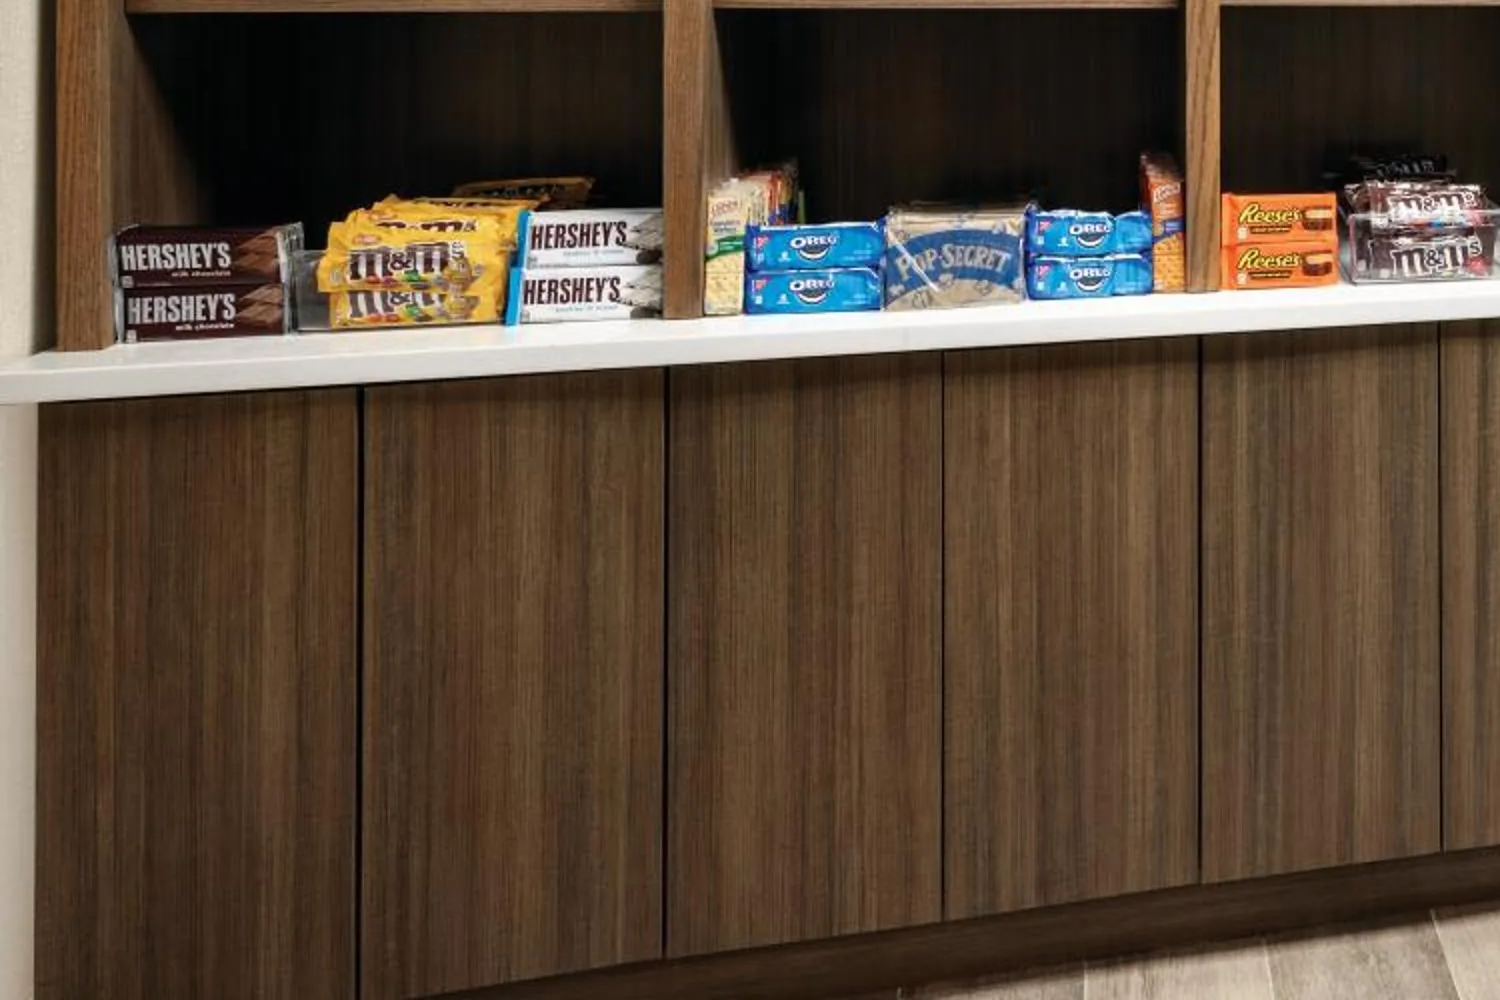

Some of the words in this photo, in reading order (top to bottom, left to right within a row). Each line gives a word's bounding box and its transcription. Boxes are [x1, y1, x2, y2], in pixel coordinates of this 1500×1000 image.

[1239, 202, 1303, 224] Reese's
[531, 221, 628, 250] HERSHEY'S
[1069, 223, 1113, 235] OREO
[789, 234, 837, 249] OREO
[121, 242, 232, 272] HERSHEY'S
[942, 243, 1013, 273] SECRET
[1238, 247, 1302, 270] Reese's
[789, 279, 834, 291] OREO
[1069, 267, 1112, 280] OREO
[523, 276, 621, 306] HERSHEY'S
[127, 293, 236, 325] HERSHEY'S
